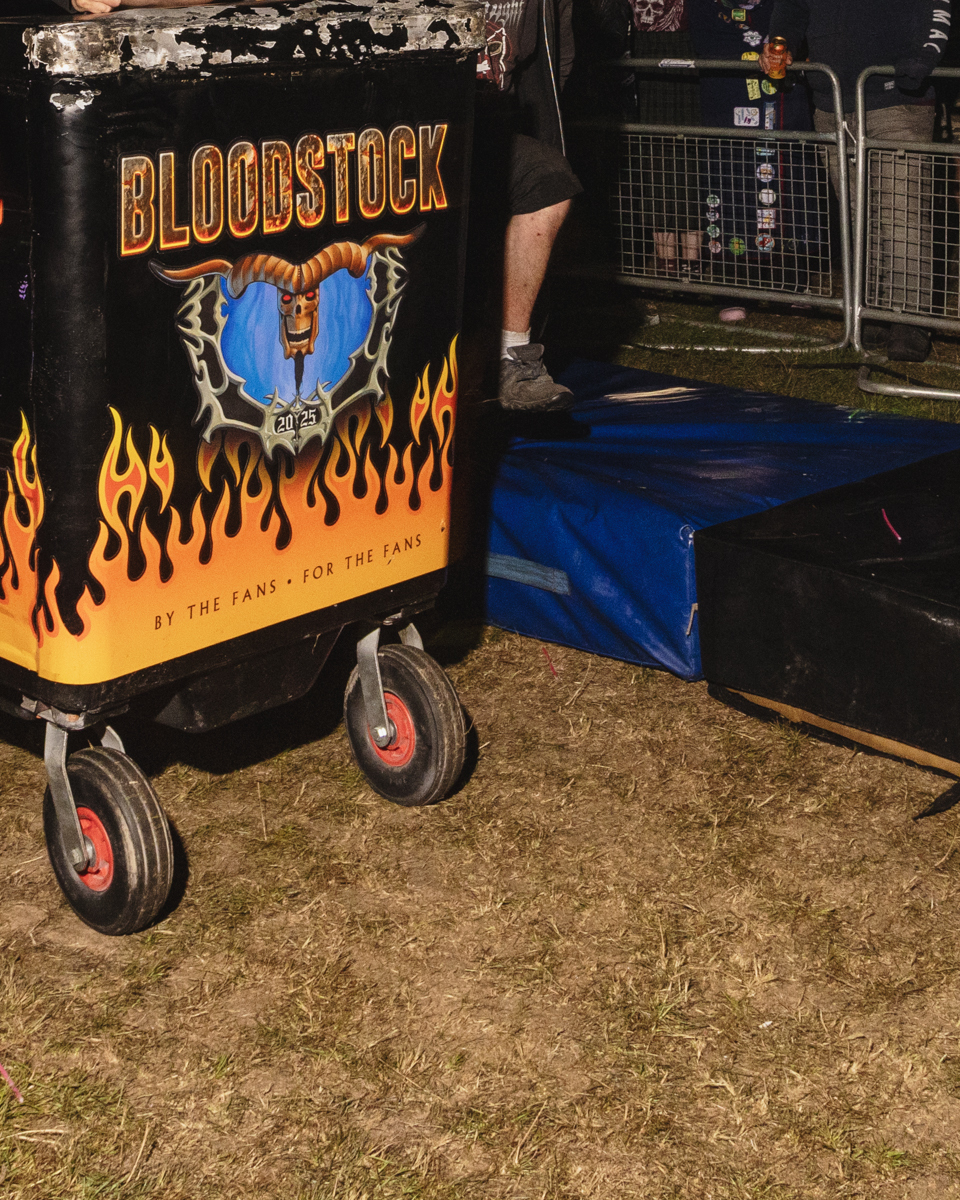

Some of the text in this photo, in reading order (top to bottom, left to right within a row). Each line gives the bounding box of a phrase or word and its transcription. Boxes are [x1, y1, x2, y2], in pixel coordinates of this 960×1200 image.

[120, 123, 448, 256] BLOODSTOCK
[155, 534, 421, 630] BY THE FANS FOR THE FANS
